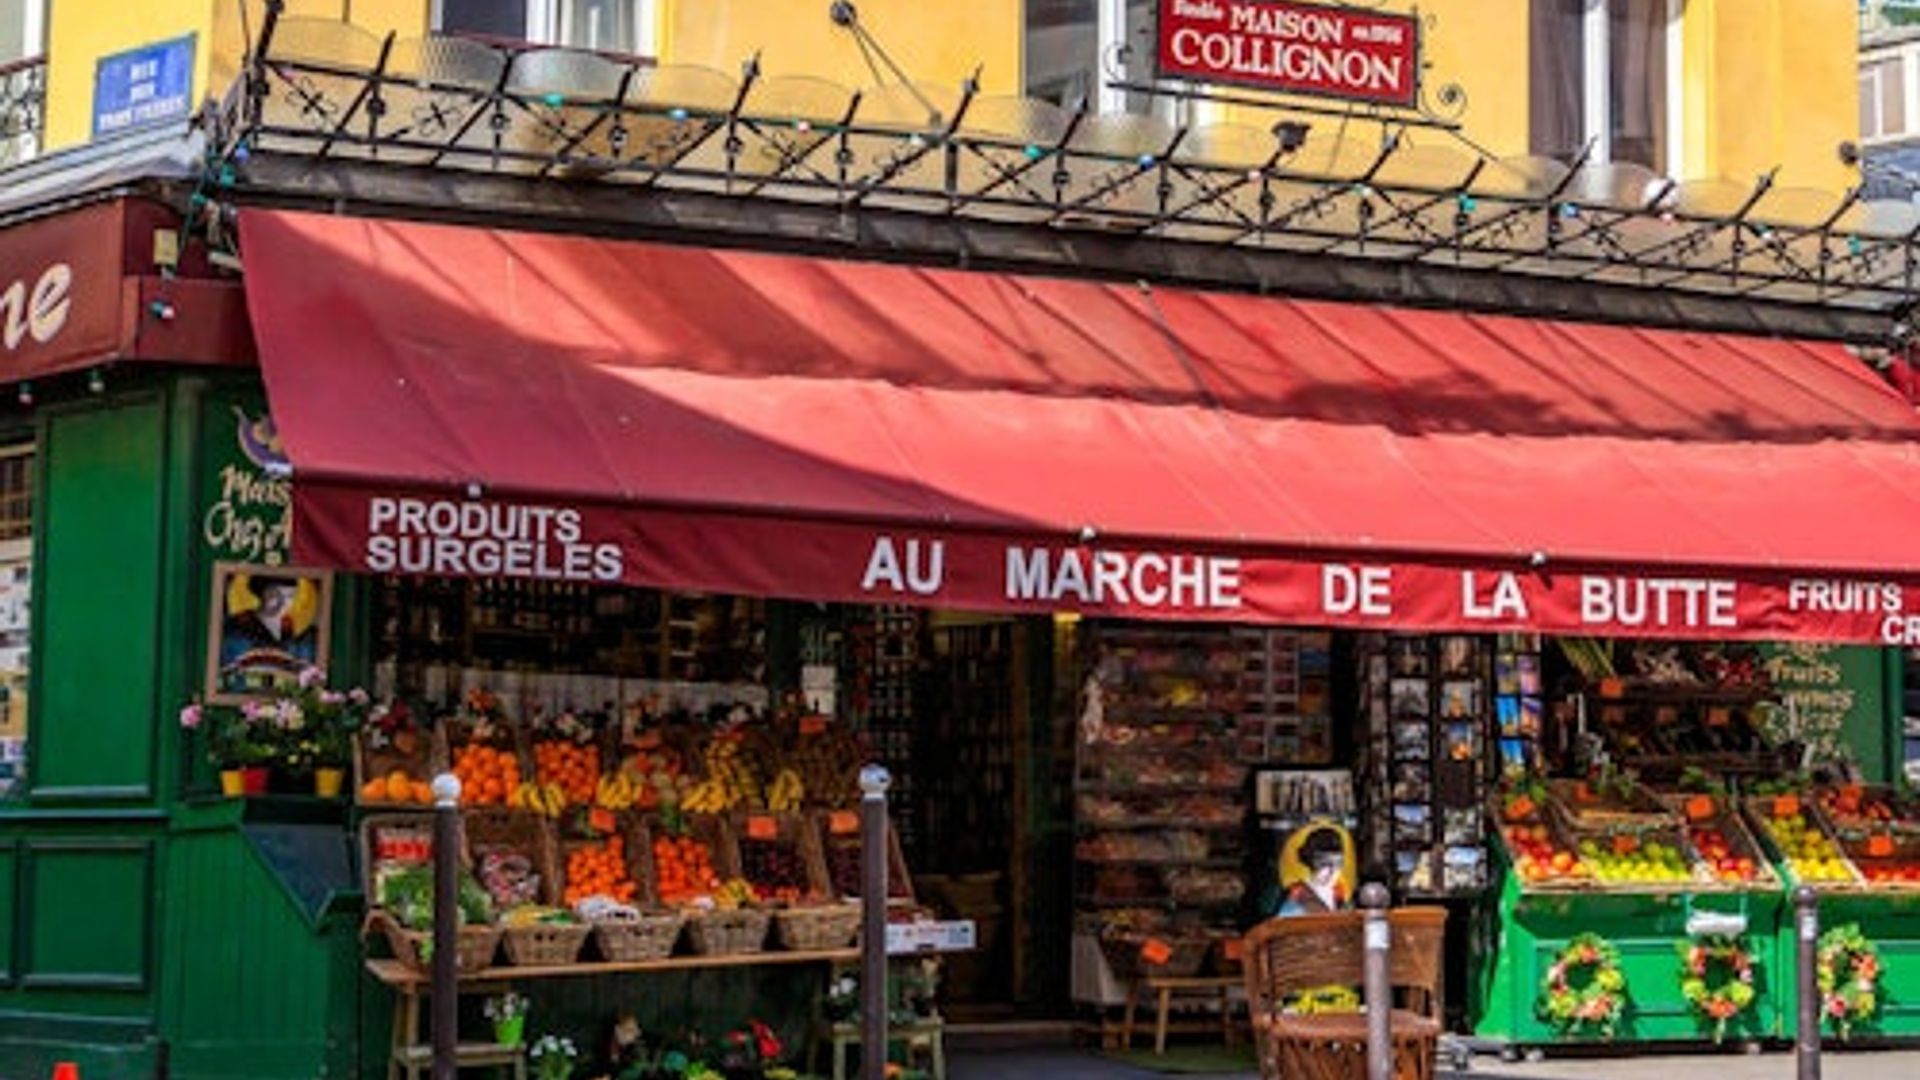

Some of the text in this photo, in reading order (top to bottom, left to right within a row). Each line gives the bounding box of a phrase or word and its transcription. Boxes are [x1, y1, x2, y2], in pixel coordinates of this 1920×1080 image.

[1230, 6, 1344, 44] MAISON
[1171, 29, 1402, 89] COLLIGNON
[369, 498, 582, 543] PRODUITS
[367, 536, 623, 580] SURGELES
[861, 536, 1738, 627] AU MARCHE DE LA BUTTE
[1788, 579, 1903, 612] FRUITS
